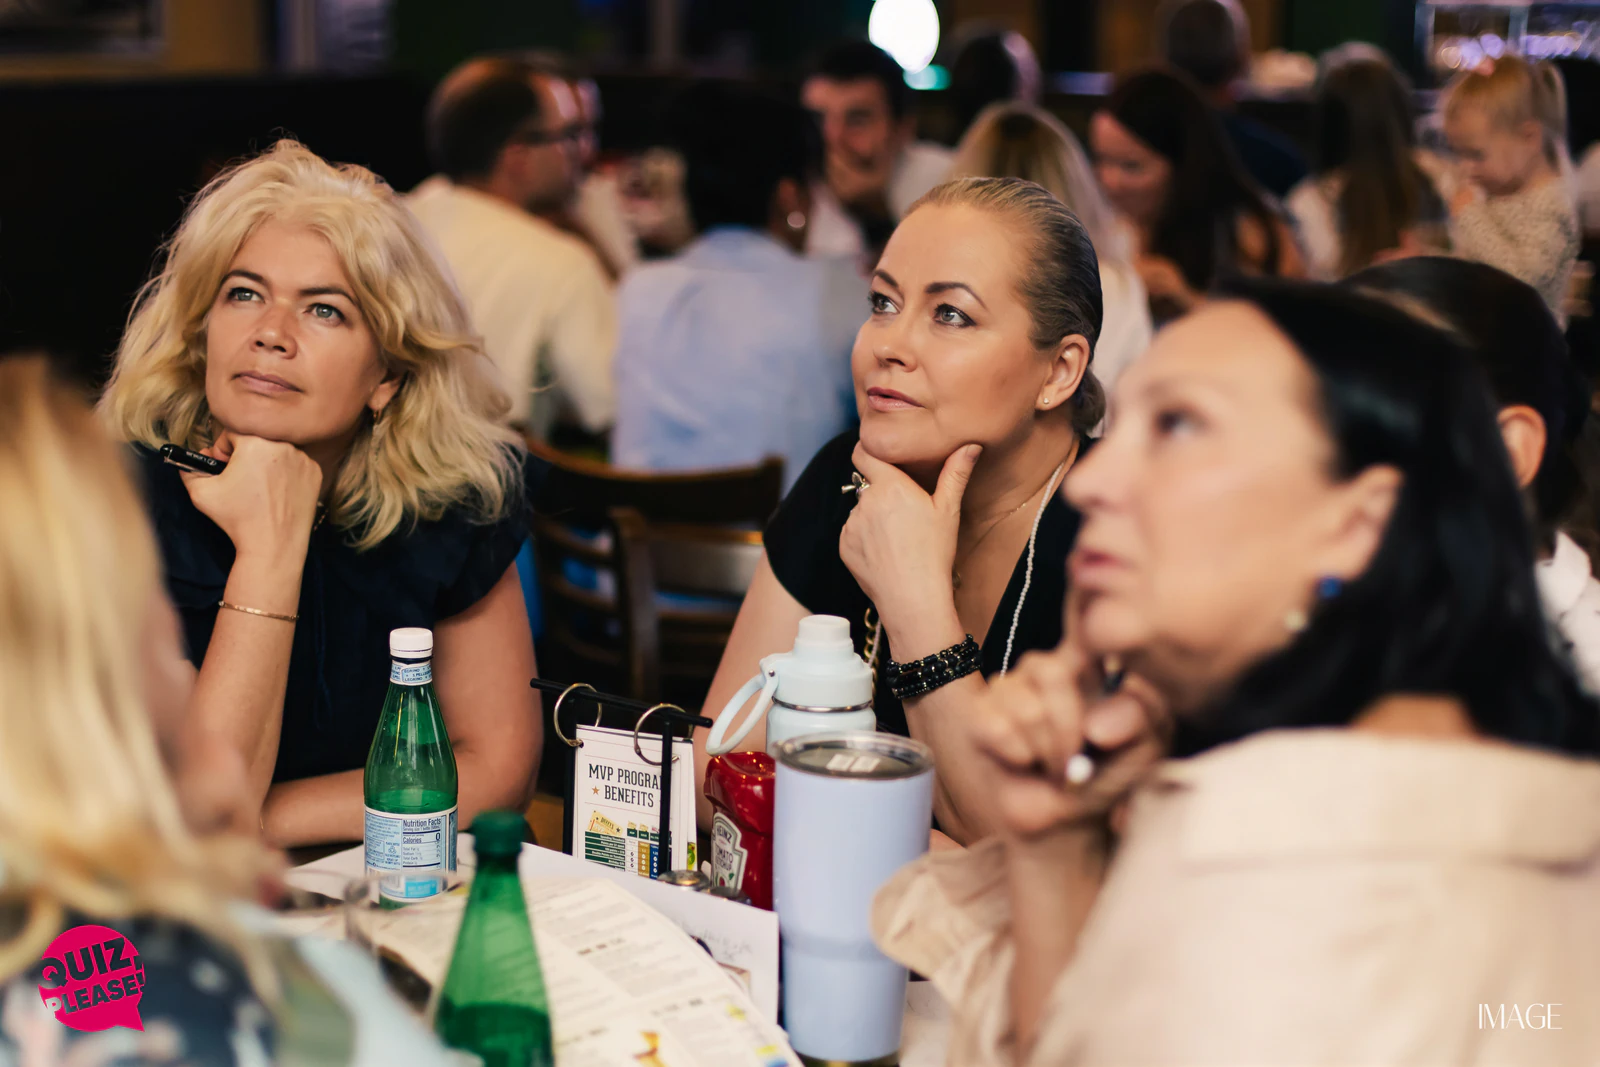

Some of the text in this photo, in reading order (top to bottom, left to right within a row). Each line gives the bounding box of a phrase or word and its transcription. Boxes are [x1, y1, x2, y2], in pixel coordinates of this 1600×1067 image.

[588, 763, 662, 790] MVP PROGRA
[604, 784, 654, 808] BENEFITS
[403, 818, 441, 828] Nutrition Facts
[435, 832, 441, 841] 0
